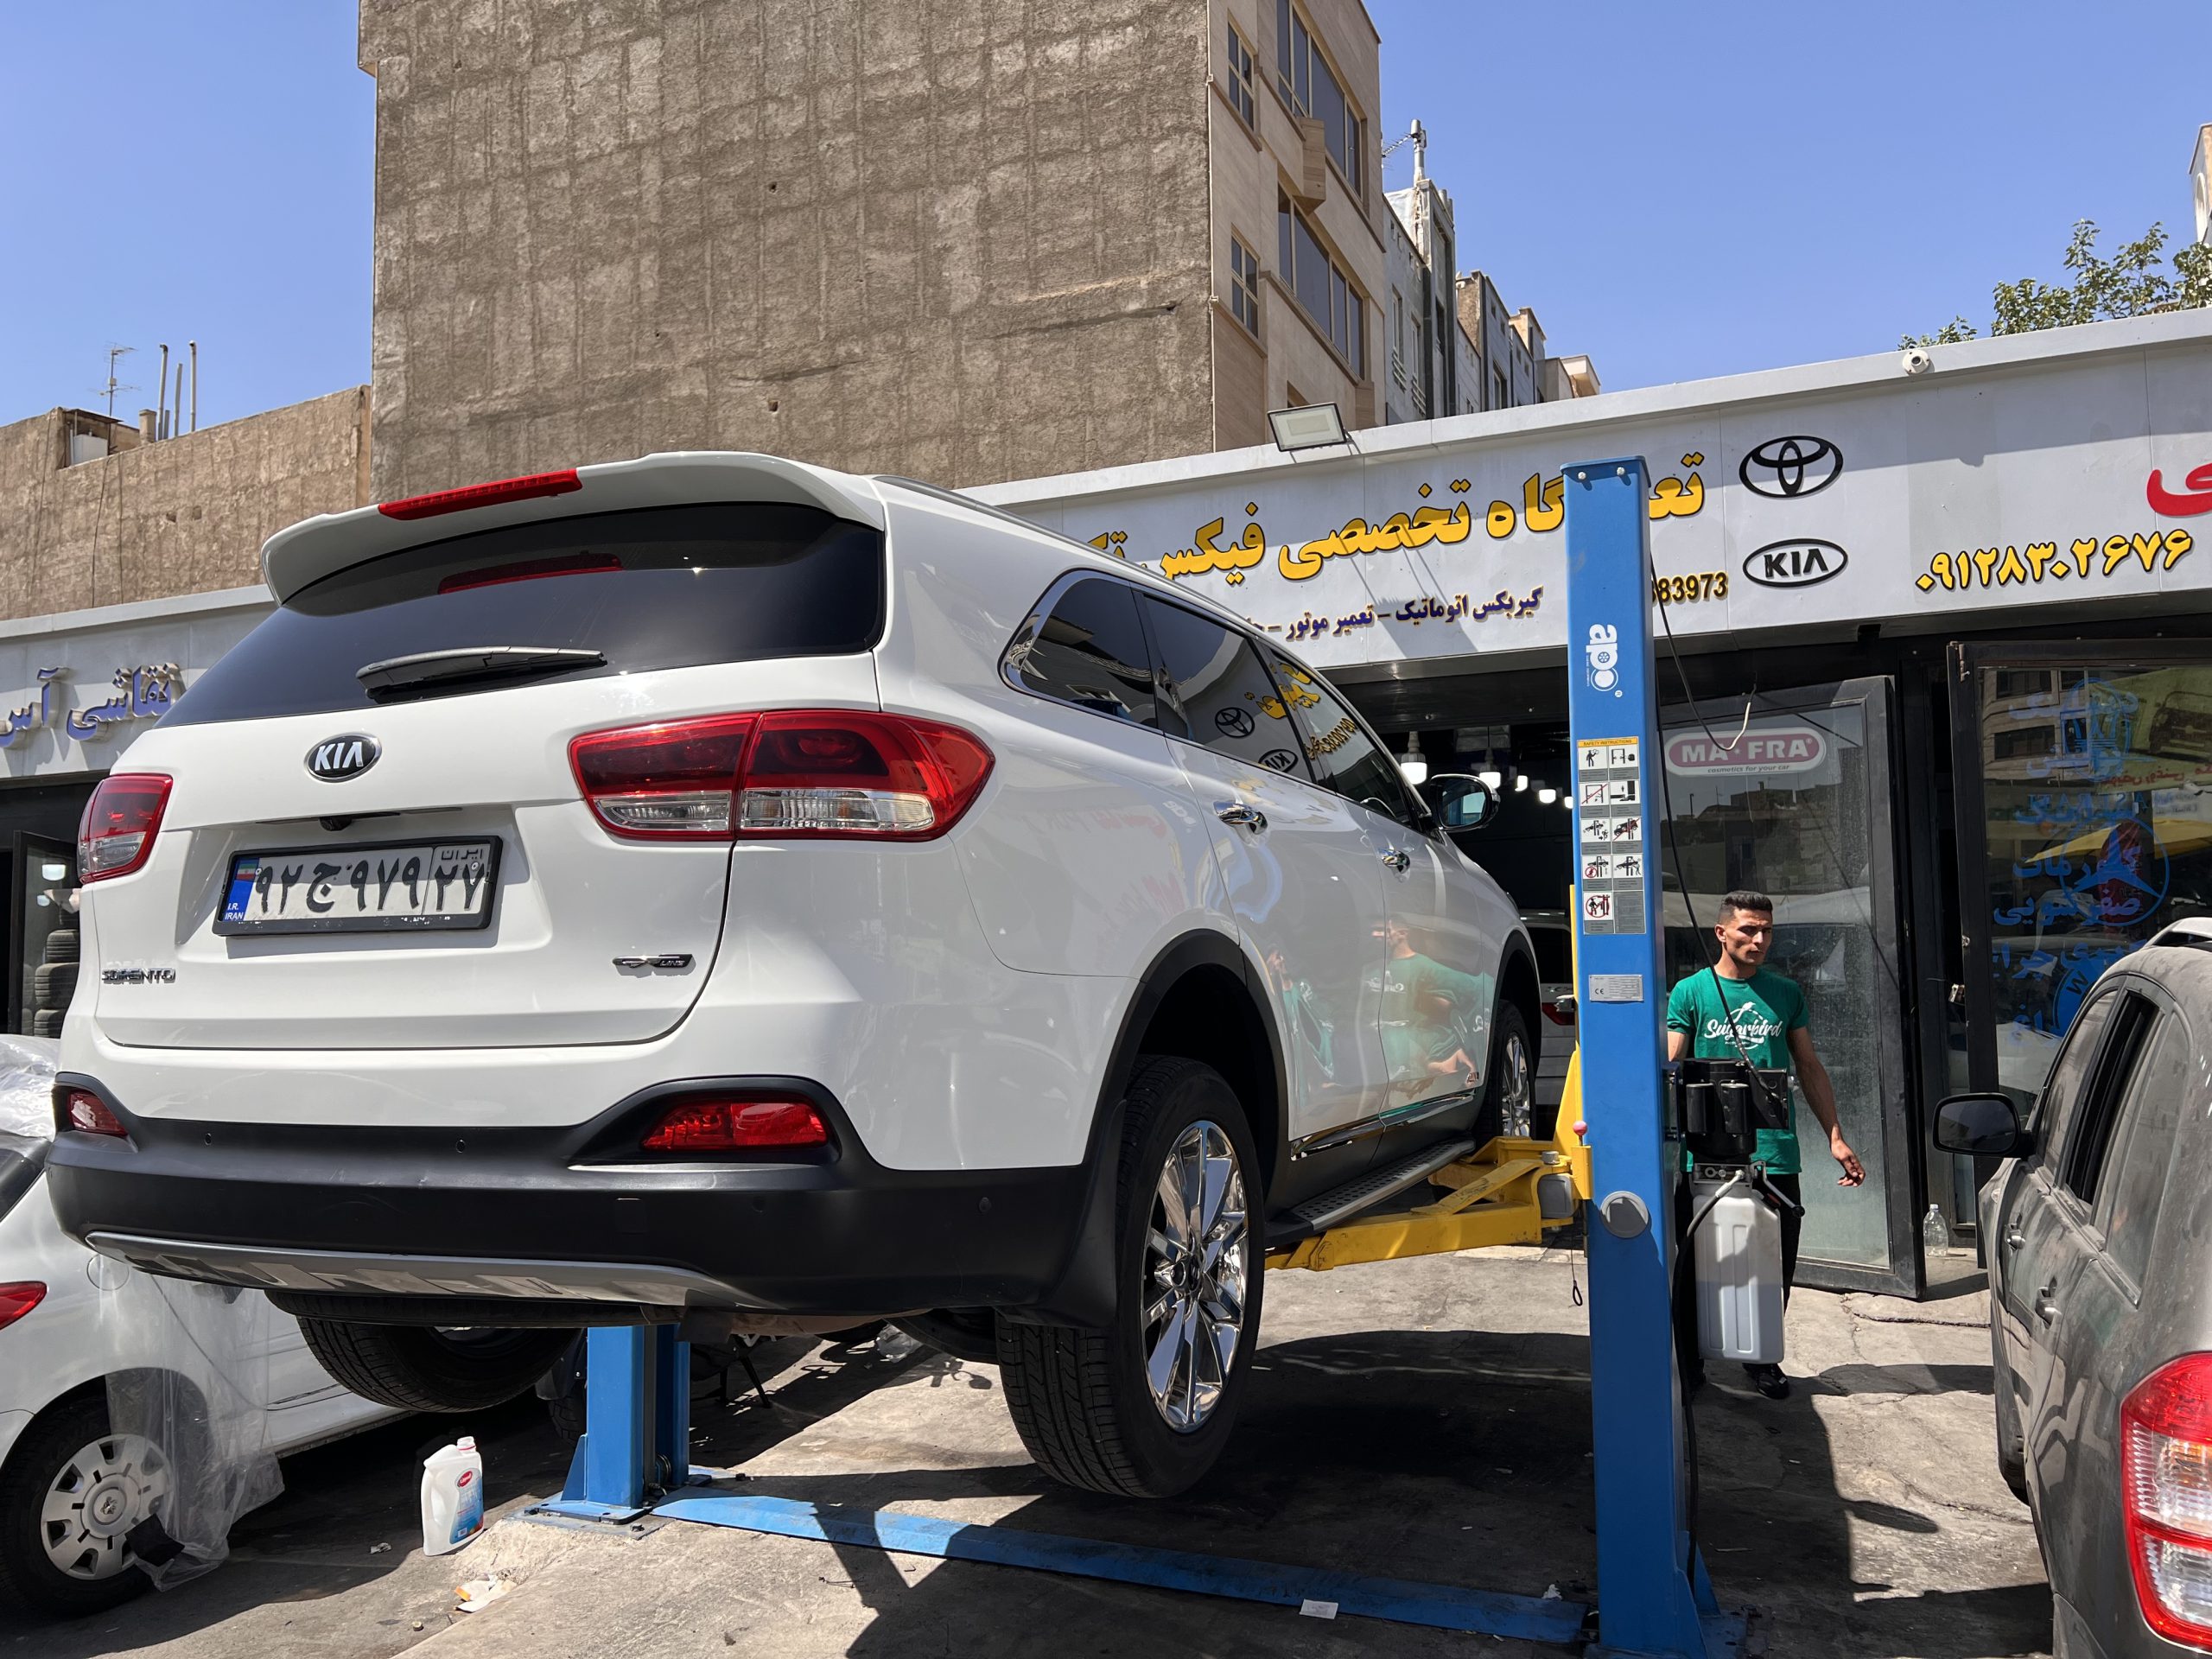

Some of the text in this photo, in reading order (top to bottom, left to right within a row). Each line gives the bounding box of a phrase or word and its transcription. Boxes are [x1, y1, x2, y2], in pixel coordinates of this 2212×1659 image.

[1279, 477, 1471, 581] تخصصی
[1764, 548, 1829, 579] KIA
[1472, 584, 1544, 620] گیربکس
[1651, 571, 1728, 603] 83973
[1332, 604, 1376, 635] تعمیر
[1395, 594, 1470, 625] اتوماتیک
[1286, 611, 1329, 640] موتور
[67, 662, 175, 741] نقاشی
[314, 741, 365, 772] KIA
[441, 849, 484, 861] ایران
[224, 912, 245, 920] IRAN
[101, 968, 176, 982] SORENTO
[1703, 1018, 1783, 1044] Sugarbird
